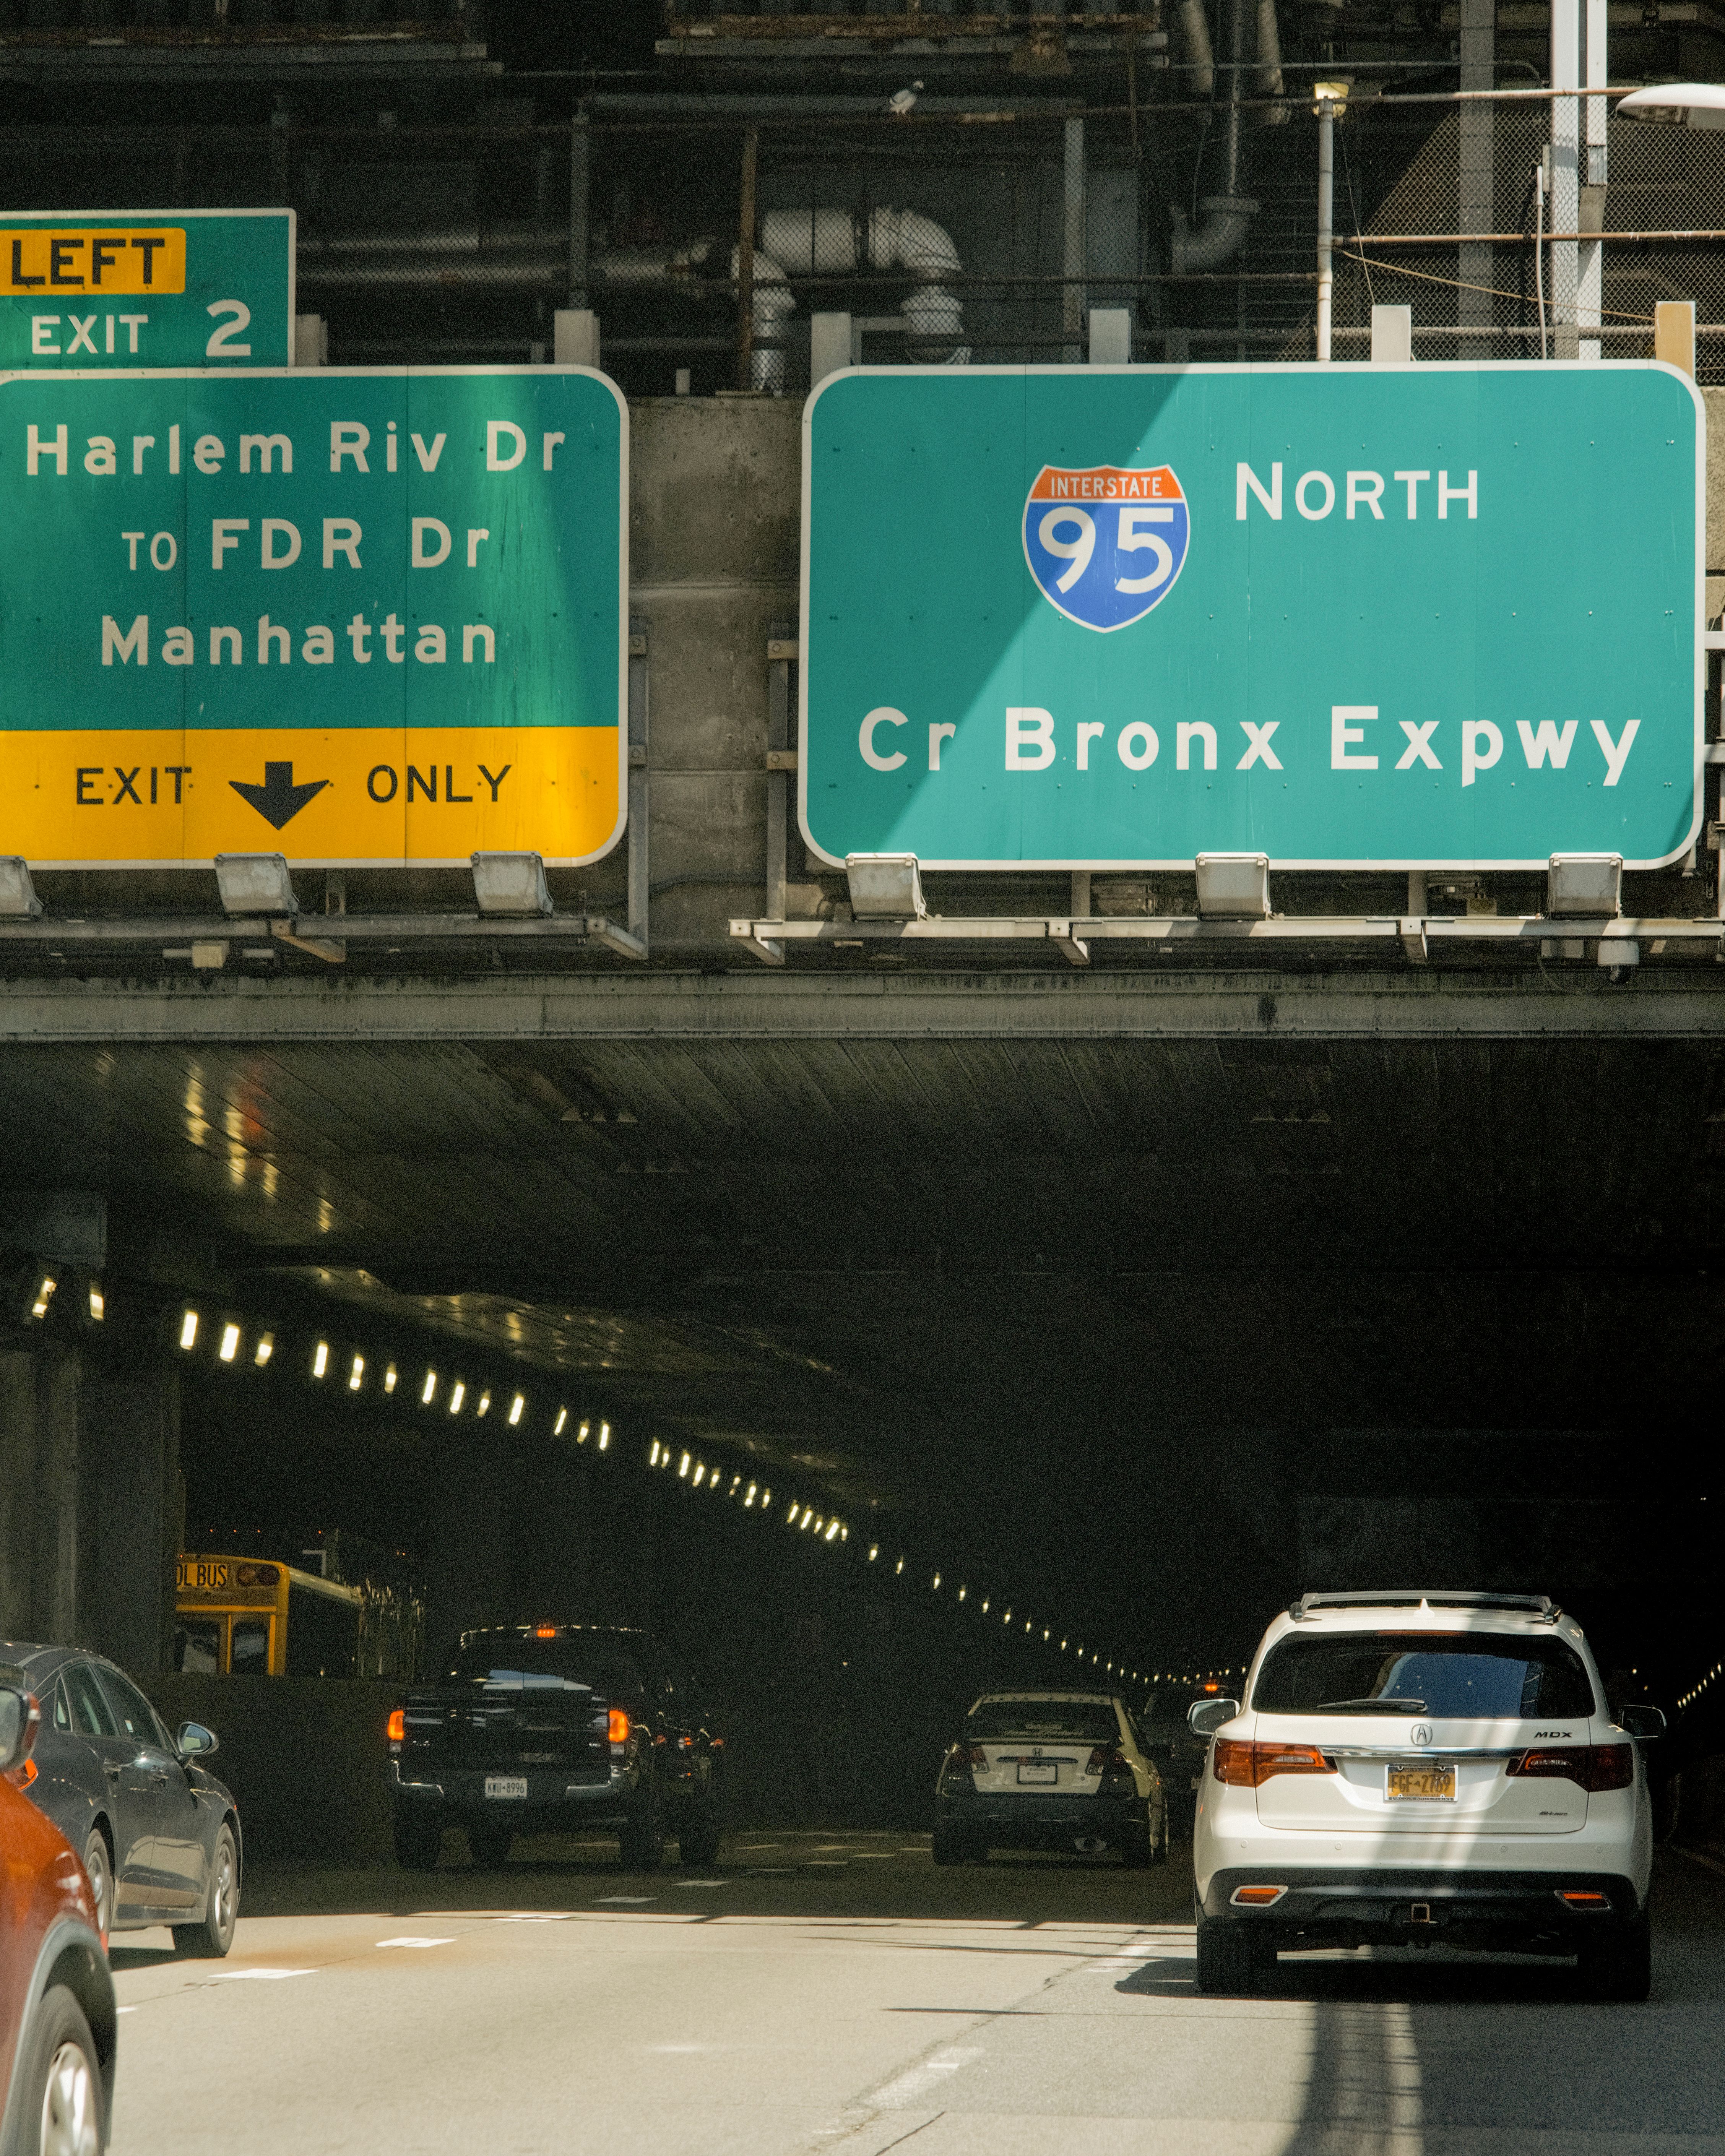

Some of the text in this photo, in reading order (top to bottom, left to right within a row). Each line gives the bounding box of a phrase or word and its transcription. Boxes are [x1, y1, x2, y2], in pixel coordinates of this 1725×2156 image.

[12, 238, 165, 286] LEFT
[32, 300, 251, 357] EXIT 2
[27, 420, 565, 475] Harlem Riv Dr
[1051, 476, 1162, 497] INTERSTATE
[1236, 462, 1477, 520] NORTH
[122, 518, 489, 570] TO FDR Dr
[1039, 506, 1174, 594] 95
[102, 613, 495, 665] Manhattan
[859, 706, 1641, 787] Cr Bronx Expwy
[77, 765, 511, 804] EXIT ONLY
[197, 1565, 226, 1587] BUS
